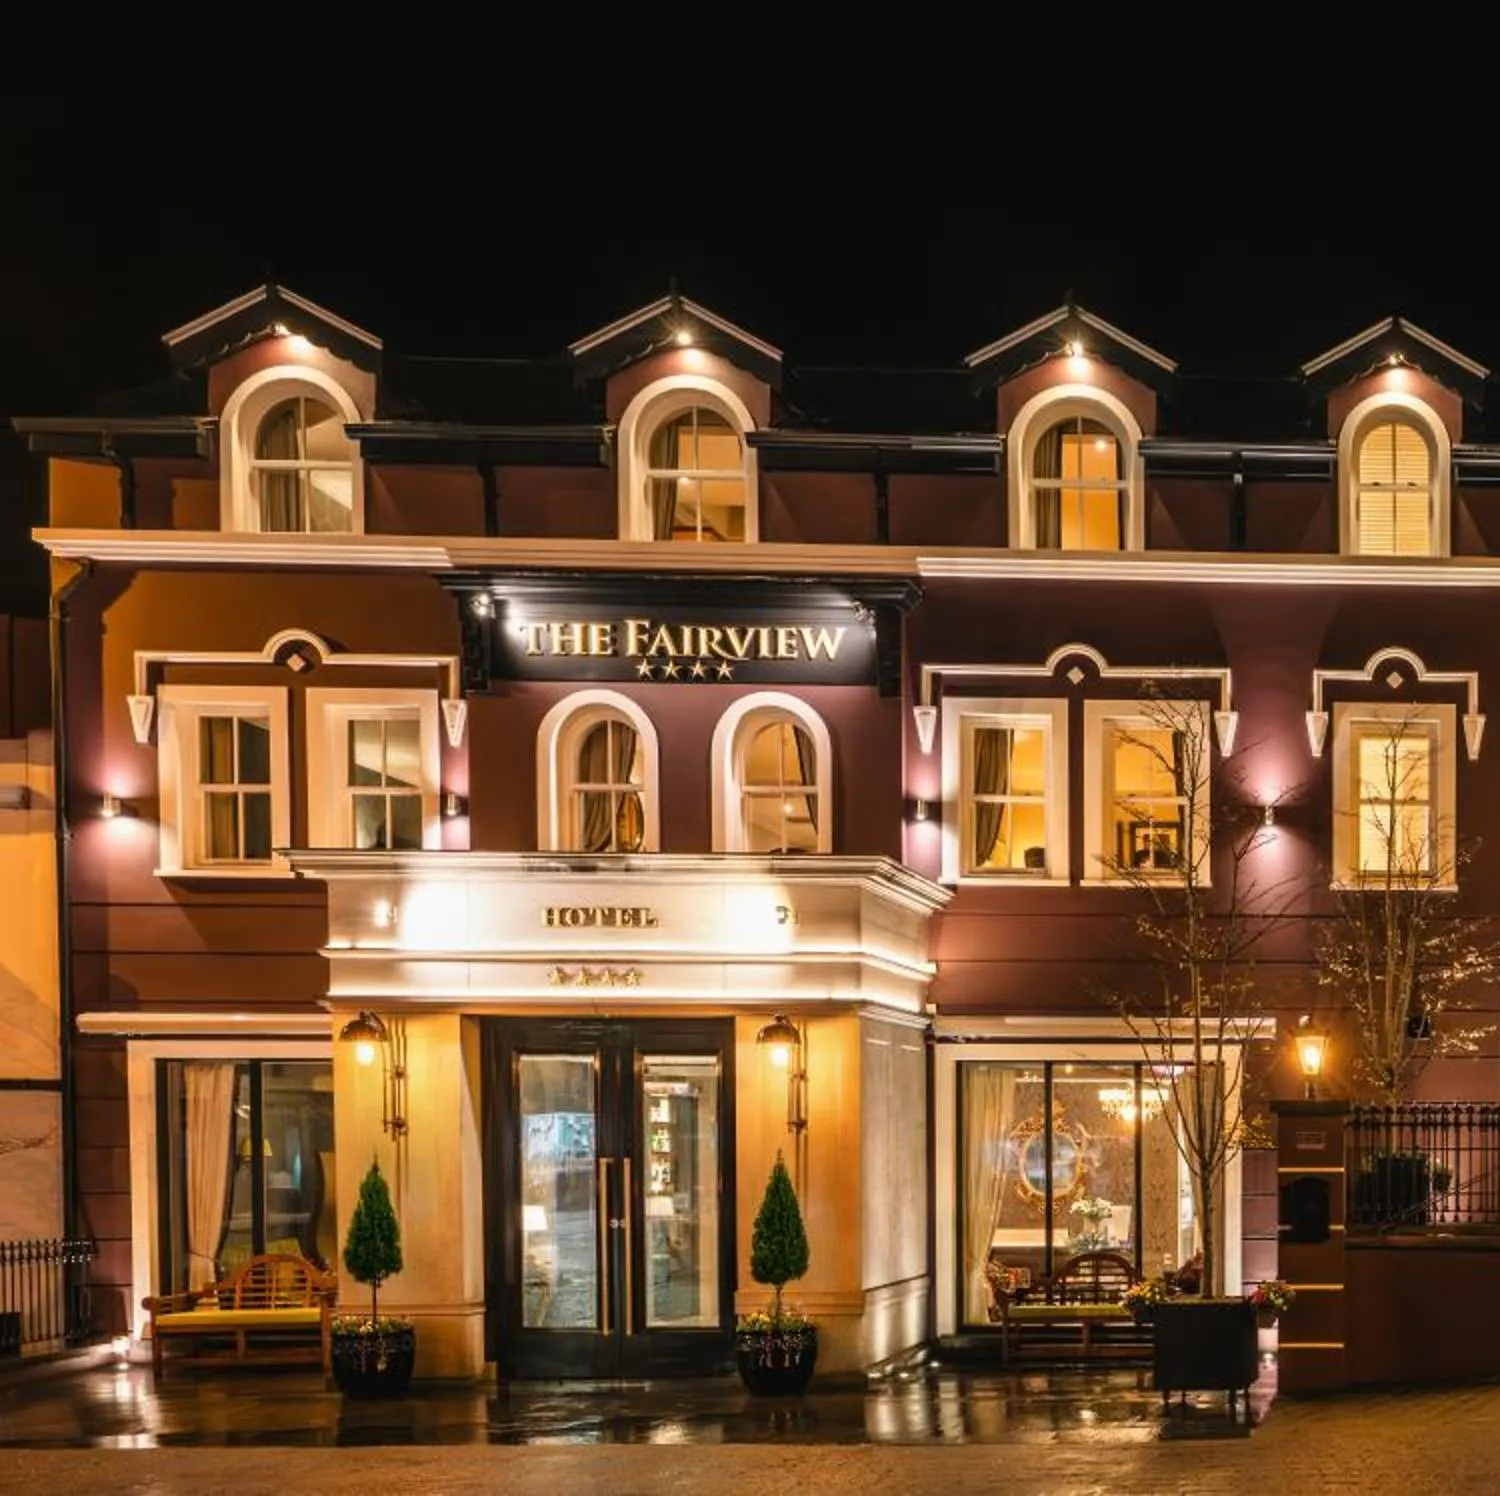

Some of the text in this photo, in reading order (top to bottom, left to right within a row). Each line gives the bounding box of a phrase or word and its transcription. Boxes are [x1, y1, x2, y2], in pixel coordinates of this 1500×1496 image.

[521, 618, 847, 661] THE FAIRVIEW
[541, 906, 658, 928] HOTEL
